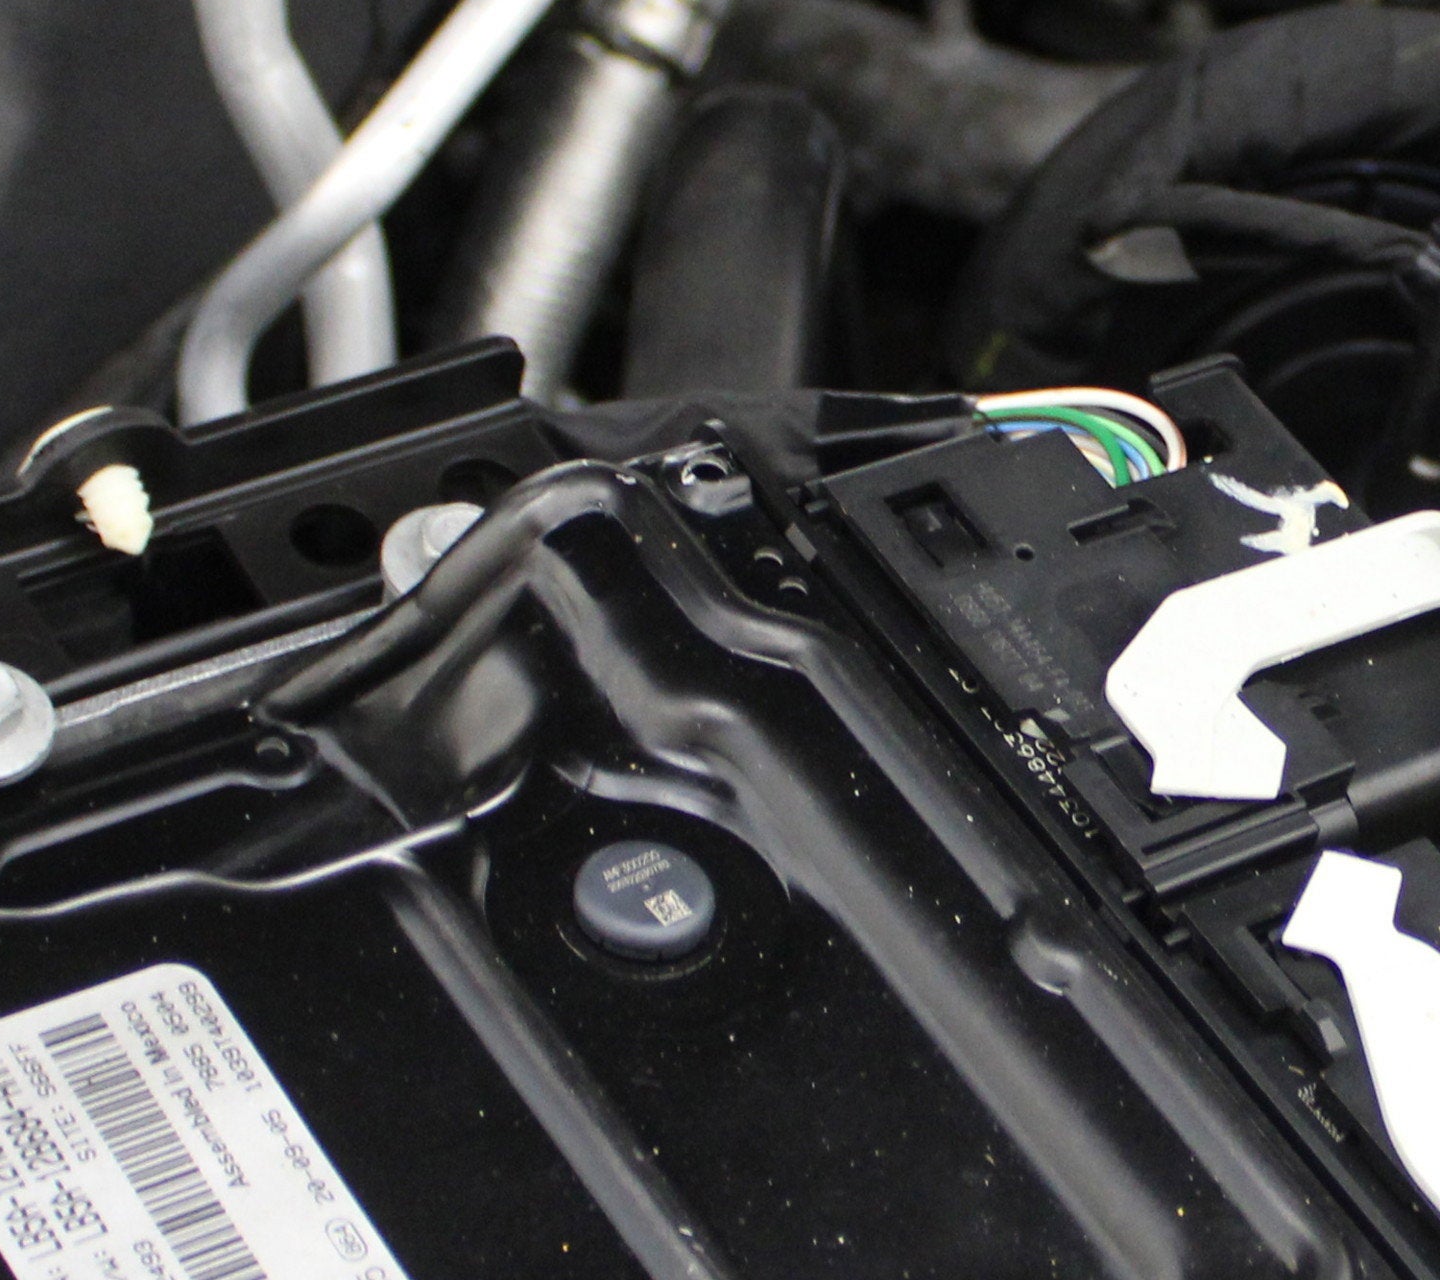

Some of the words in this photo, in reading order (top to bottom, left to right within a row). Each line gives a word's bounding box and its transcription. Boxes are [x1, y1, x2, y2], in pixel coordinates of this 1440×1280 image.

[111, 1000, 171, 1065] Mexico
[154, 1065, 183, 1086] in
[45, 1104, 98, 1163] SITE:
[166, 1087, 254, 1192] Assembled
